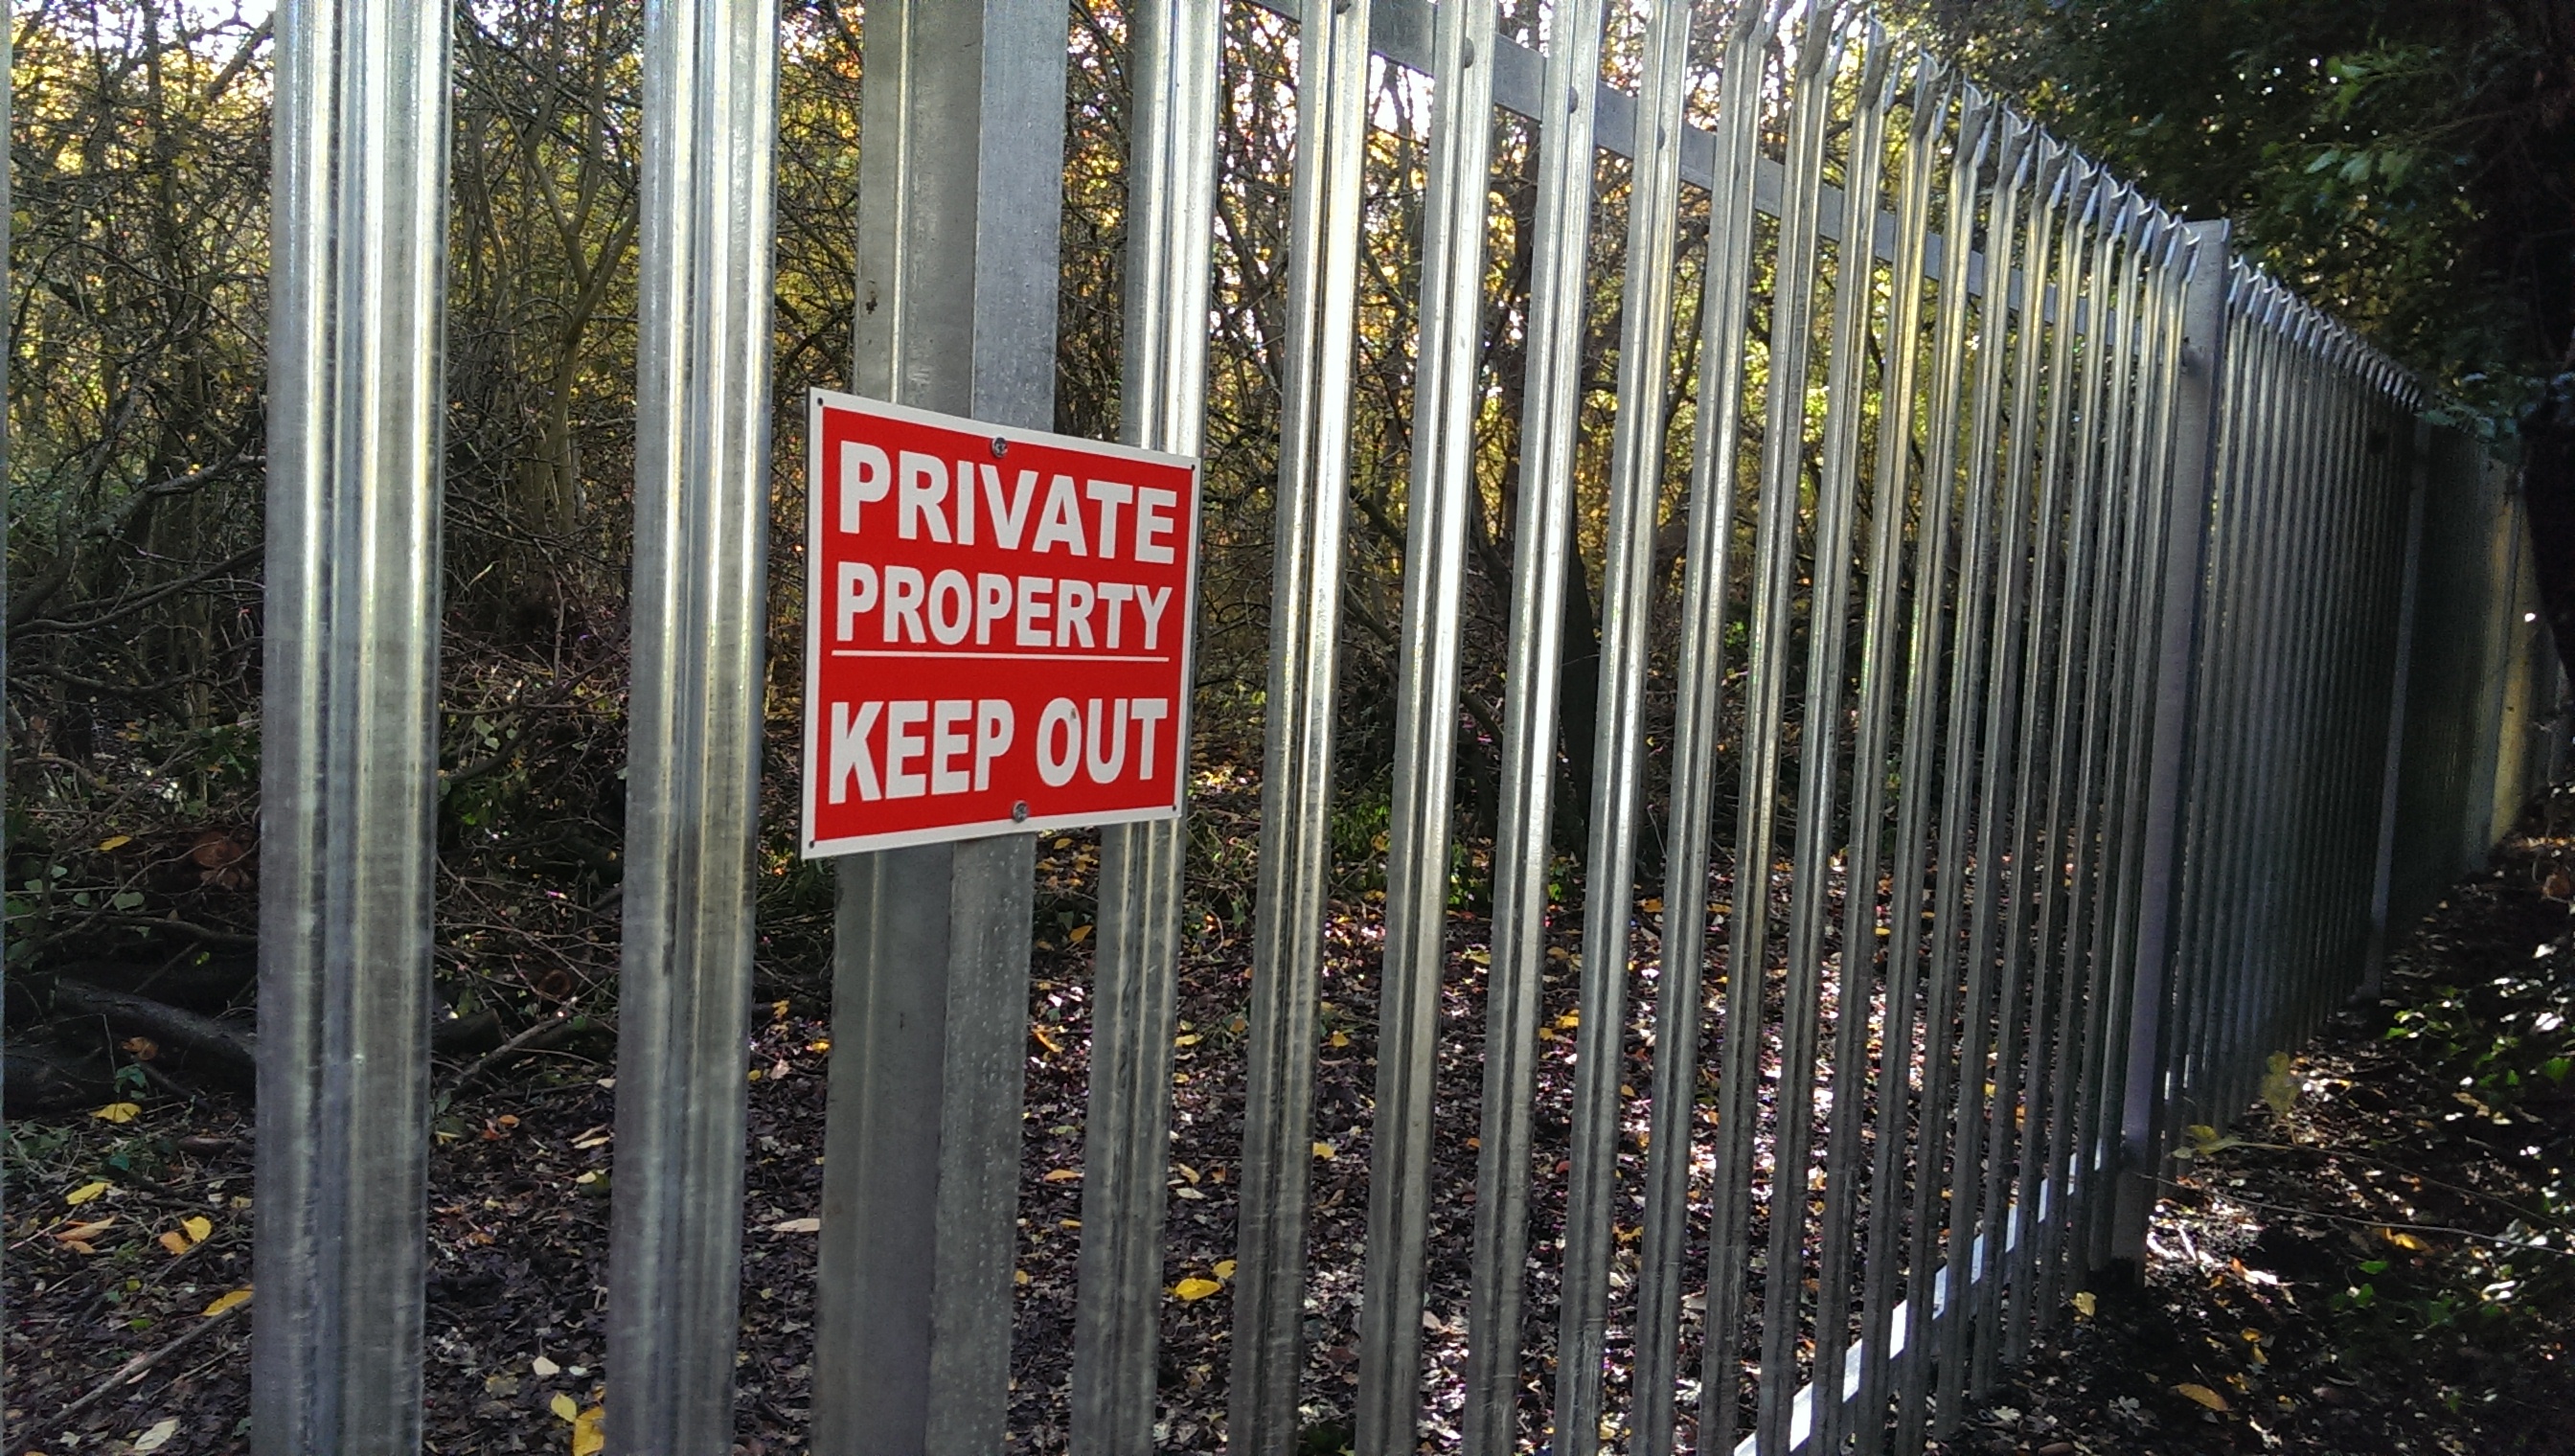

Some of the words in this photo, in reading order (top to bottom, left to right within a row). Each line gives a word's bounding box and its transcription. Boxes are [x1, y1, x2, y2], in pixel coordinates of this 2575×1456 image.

[839, 440, 1177, 564] PRIVATE
[836, 561, 1173, 650] PROPERTY
[829, 699, 1014, 805] KEEP
[1037, 697, 1168, 787] OUT
